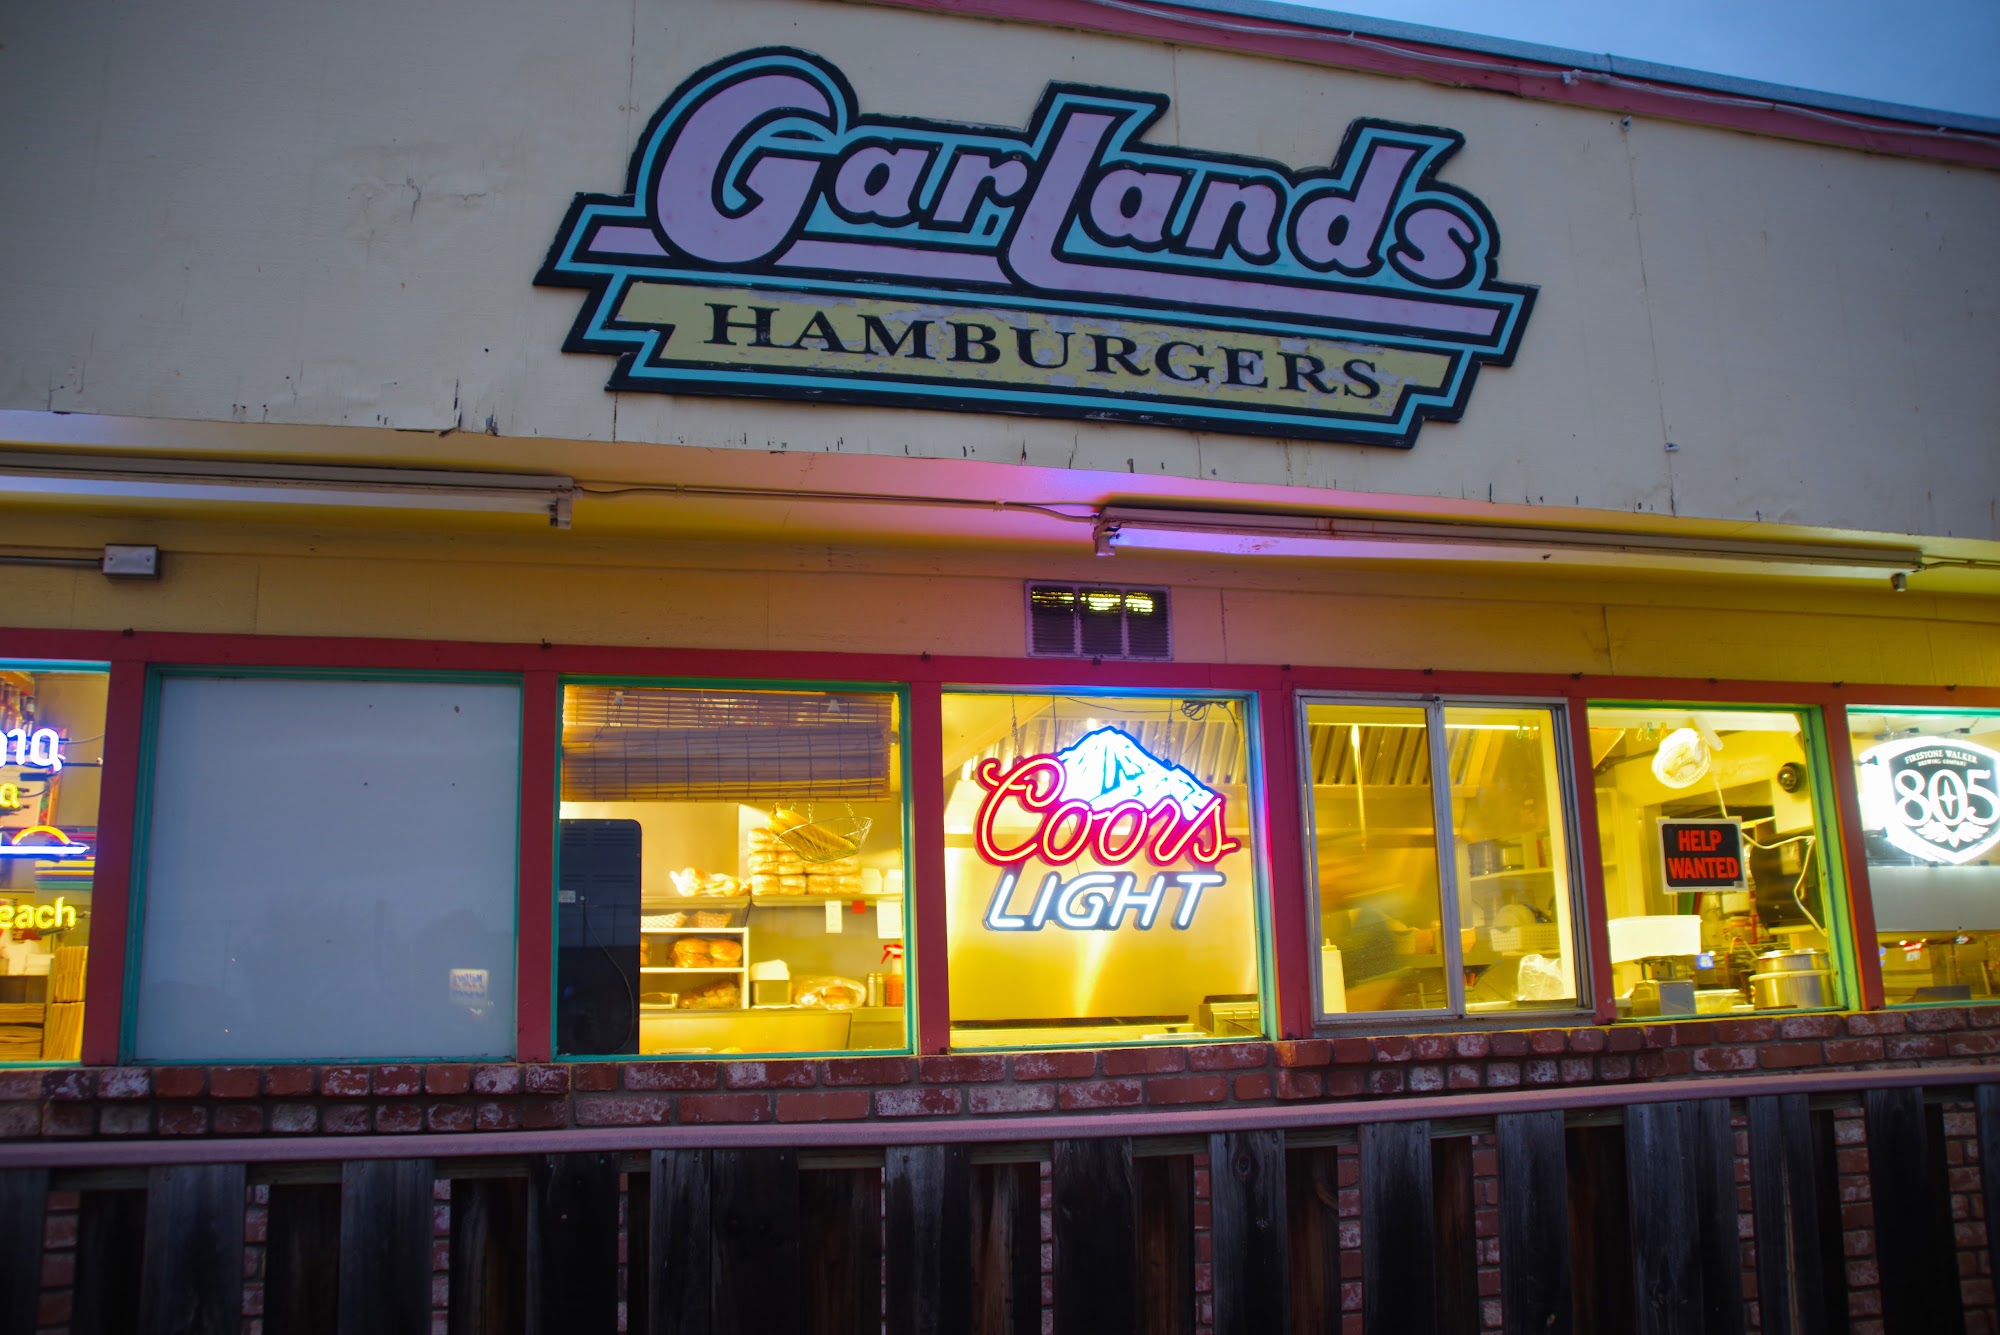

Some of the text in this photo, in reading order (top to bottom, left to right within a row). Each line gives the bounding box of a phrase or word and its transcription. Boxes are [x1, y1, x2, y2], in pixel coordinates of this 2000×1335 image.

[704, 302, 1381, 398] HAMBURGERS
[1905, 750, 1978, 764] FIRESTONE WALKER
[977, 755, 1239, 865] Coors
[1894, 769, 2000, 827] 805
[1668, 857, 1740, 879] WANTED
[1678, 830, 1723, 852] HELP
[986, 873, 1225, 929] LIGHT
